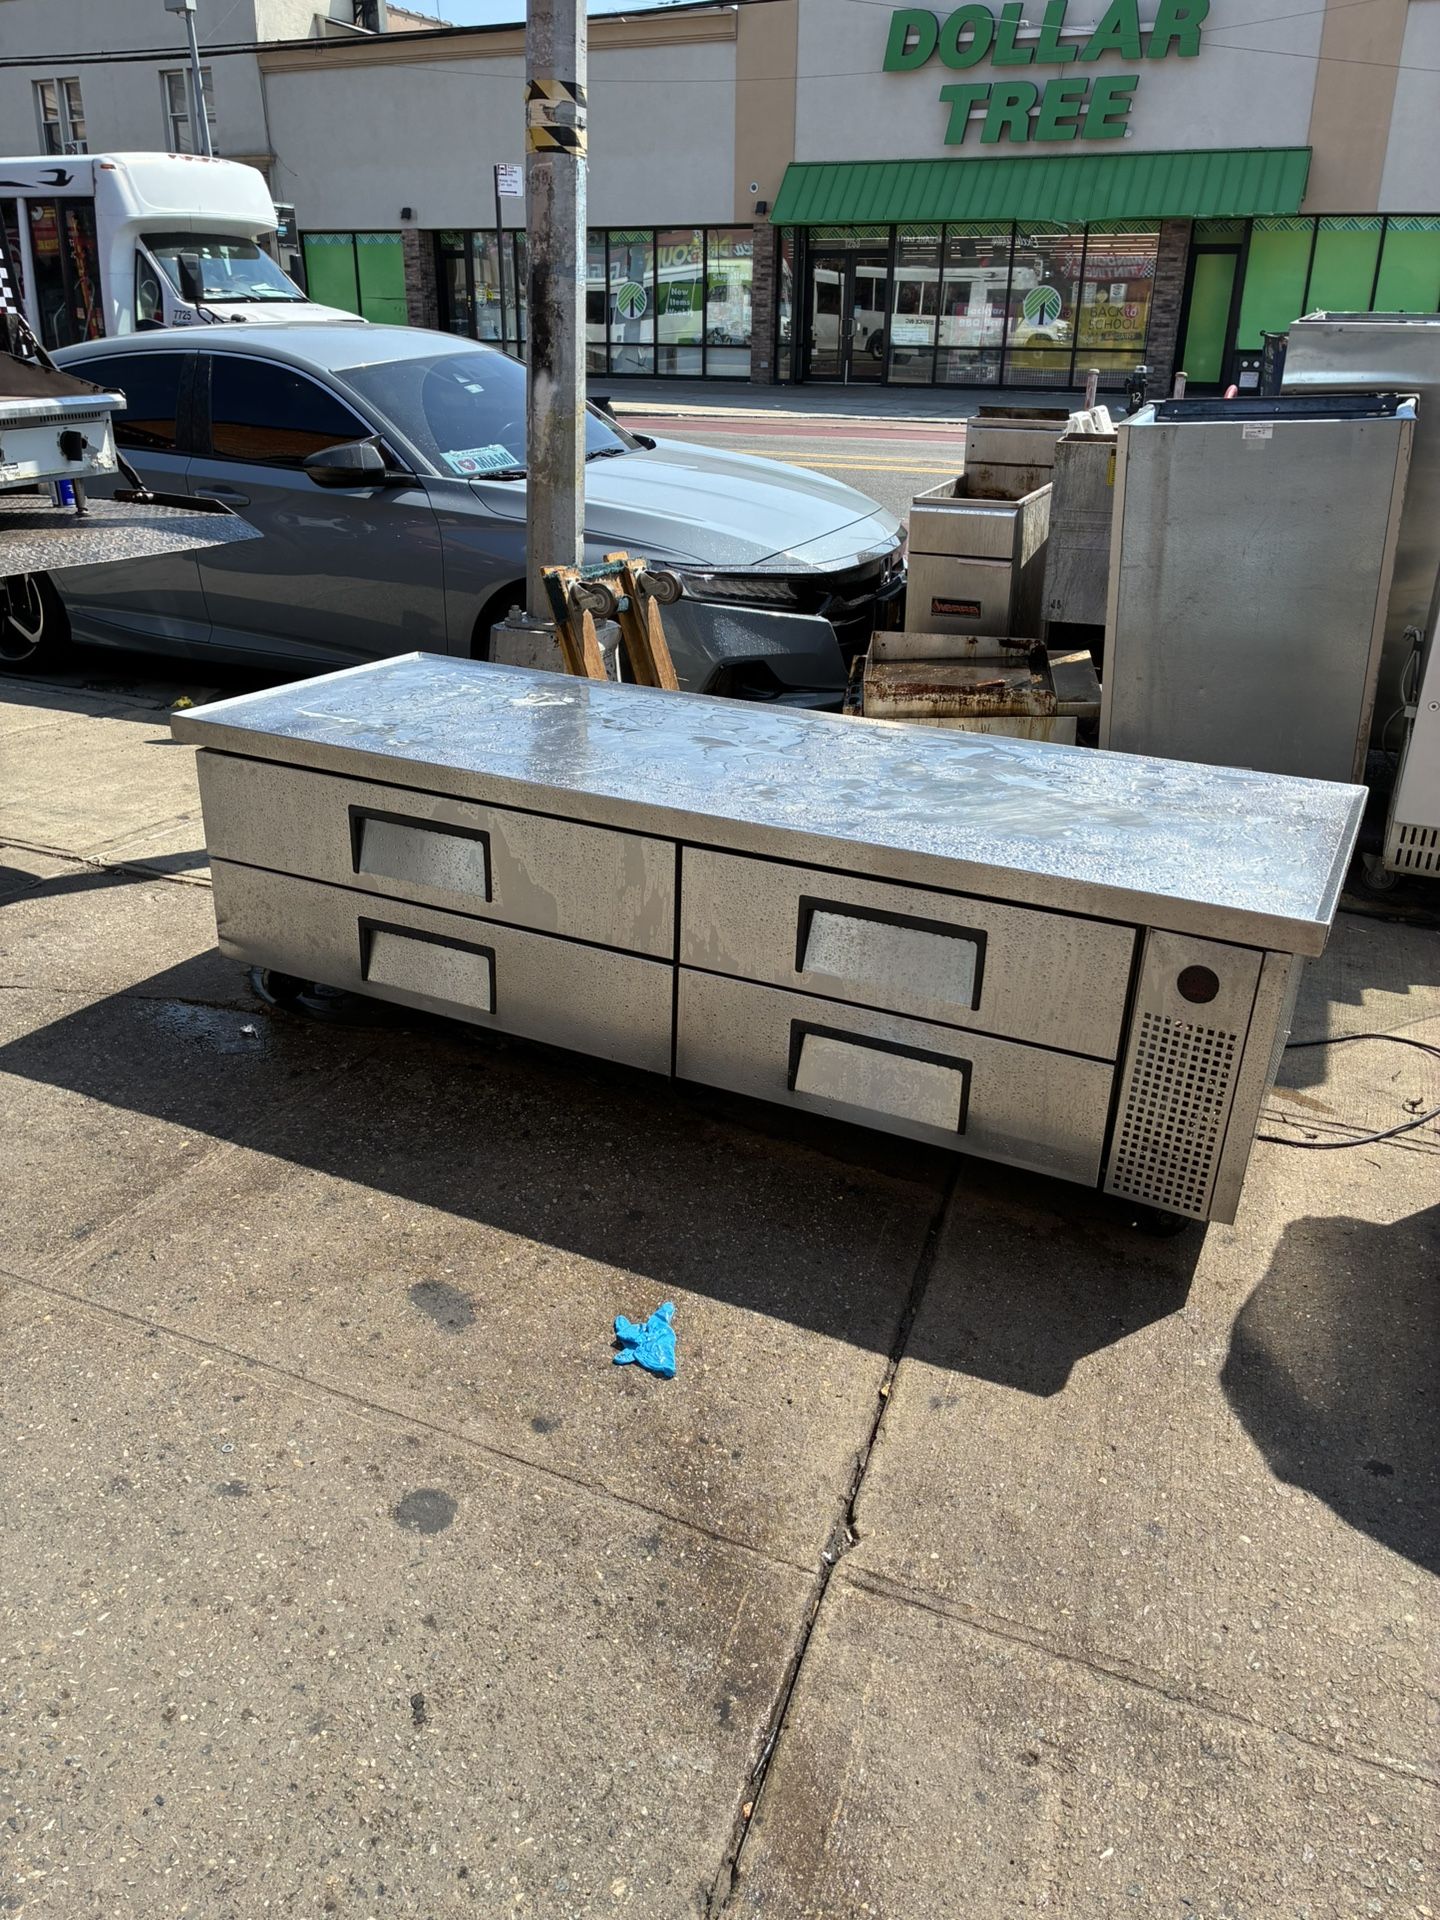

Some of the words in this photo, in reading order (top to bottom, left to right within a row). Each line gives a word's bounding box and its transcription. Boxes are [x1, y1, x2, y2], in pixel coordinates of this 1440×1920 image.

[882, 0, 1210, 72] DOLLAR
[939, 75, 1140, 145] TREE
[671, 287, 688, 295] New
[669, 298, 690, 306] Items
[173, 309, 192, 321] 7725
[1090, 306, 1124, 318] BACK
[1125, 305, 1138, 318] to
[1088, 318, 1140, 330] SCHOOL
[1132, 392, 1141, 404] 12
[472, 452, 516, 470] MIAMI
